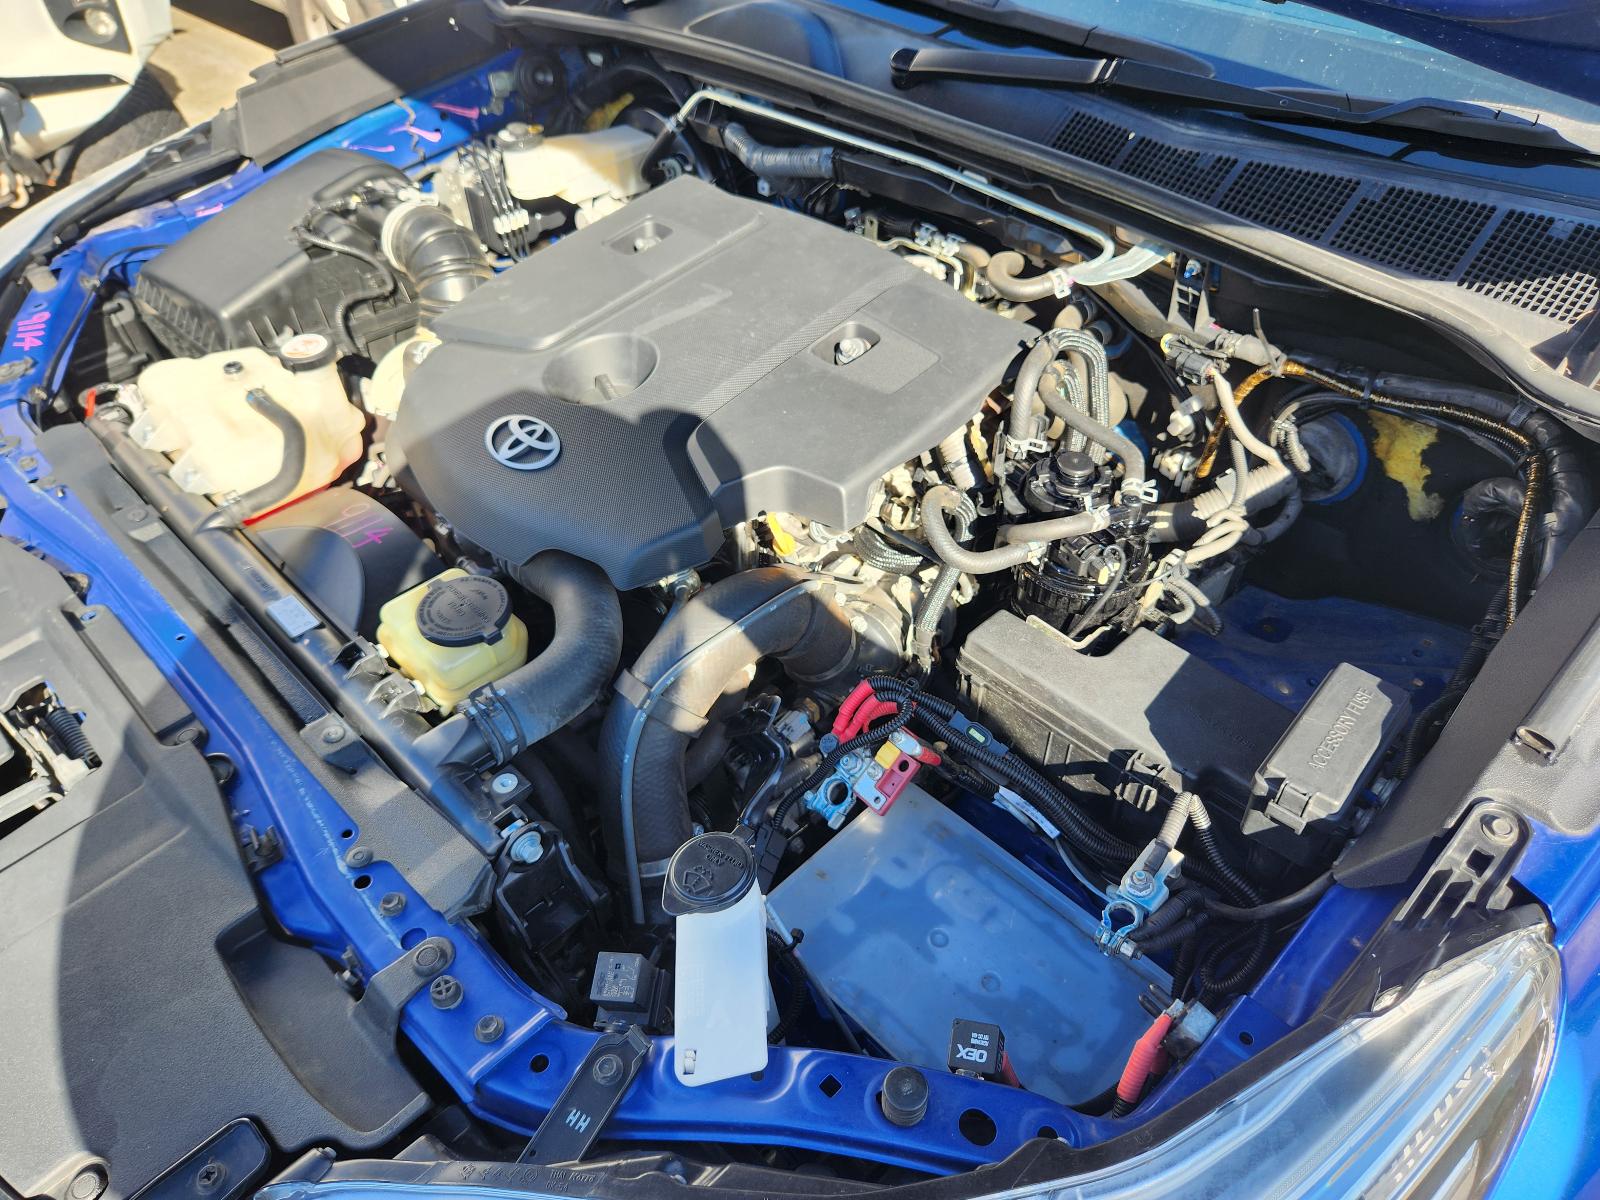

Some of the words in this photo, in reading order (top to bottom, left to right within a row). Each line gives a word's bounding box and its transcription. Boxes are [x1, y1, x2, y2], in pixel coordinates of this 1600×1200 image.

[12, 311, 51, 351] 9114
[1308, 711, 1356, 769] ACCESSORY
[1348, 687, 1375, 716] FUSE
[956, 1044, 988, 1063] OEX
